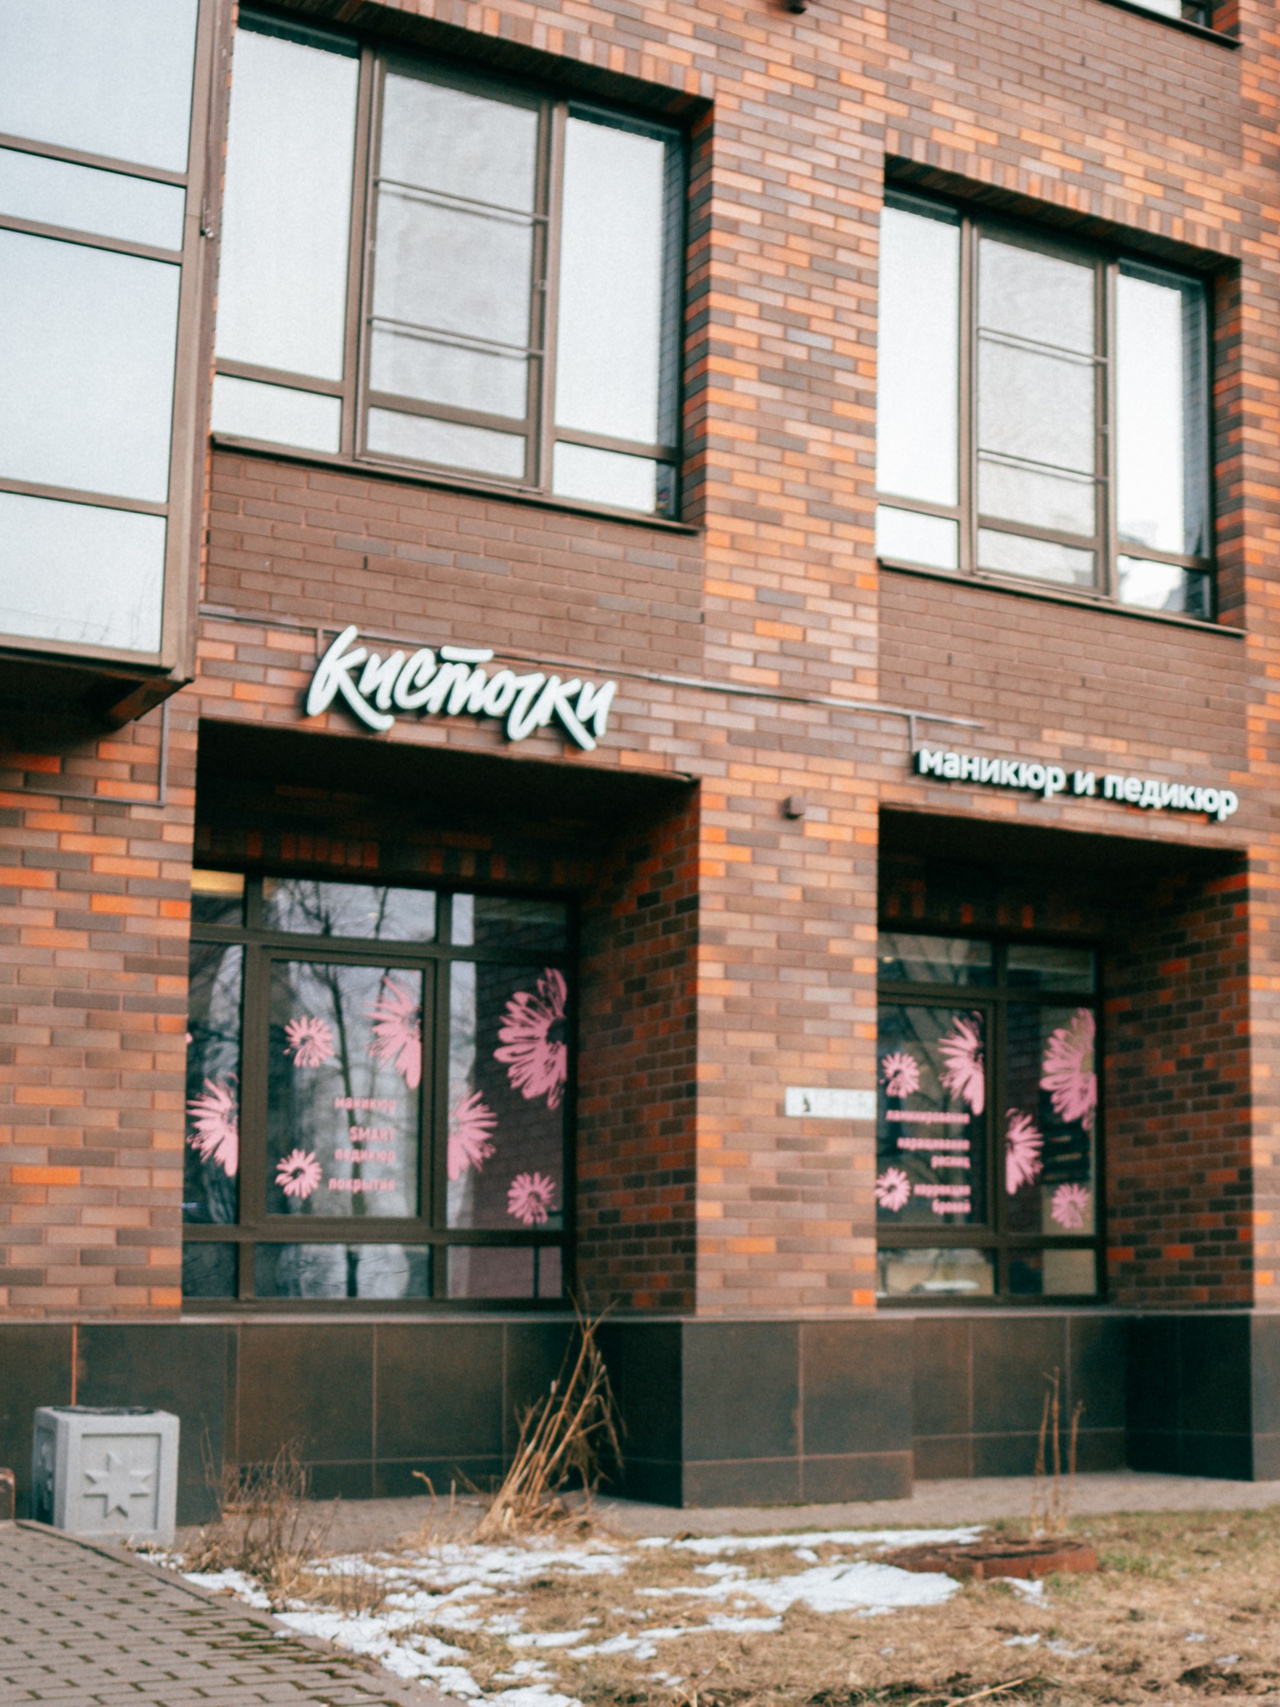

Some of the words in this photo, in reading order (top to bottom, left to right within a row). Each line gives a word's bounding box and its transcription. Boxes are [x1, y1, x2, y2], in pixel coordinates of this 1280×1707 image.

[918, 748, 1067, 799] маникюр
[1074, 769, 1096, 795] и
[1104, 774, 1240, 822] педикюр
[334, 1097, 397, 1113] маникюр
[349, 1126, 396, 1142] SMART
[334, 1149, 396, 1166] педикюр
[328, 1178, 396, 1195] покрытие
